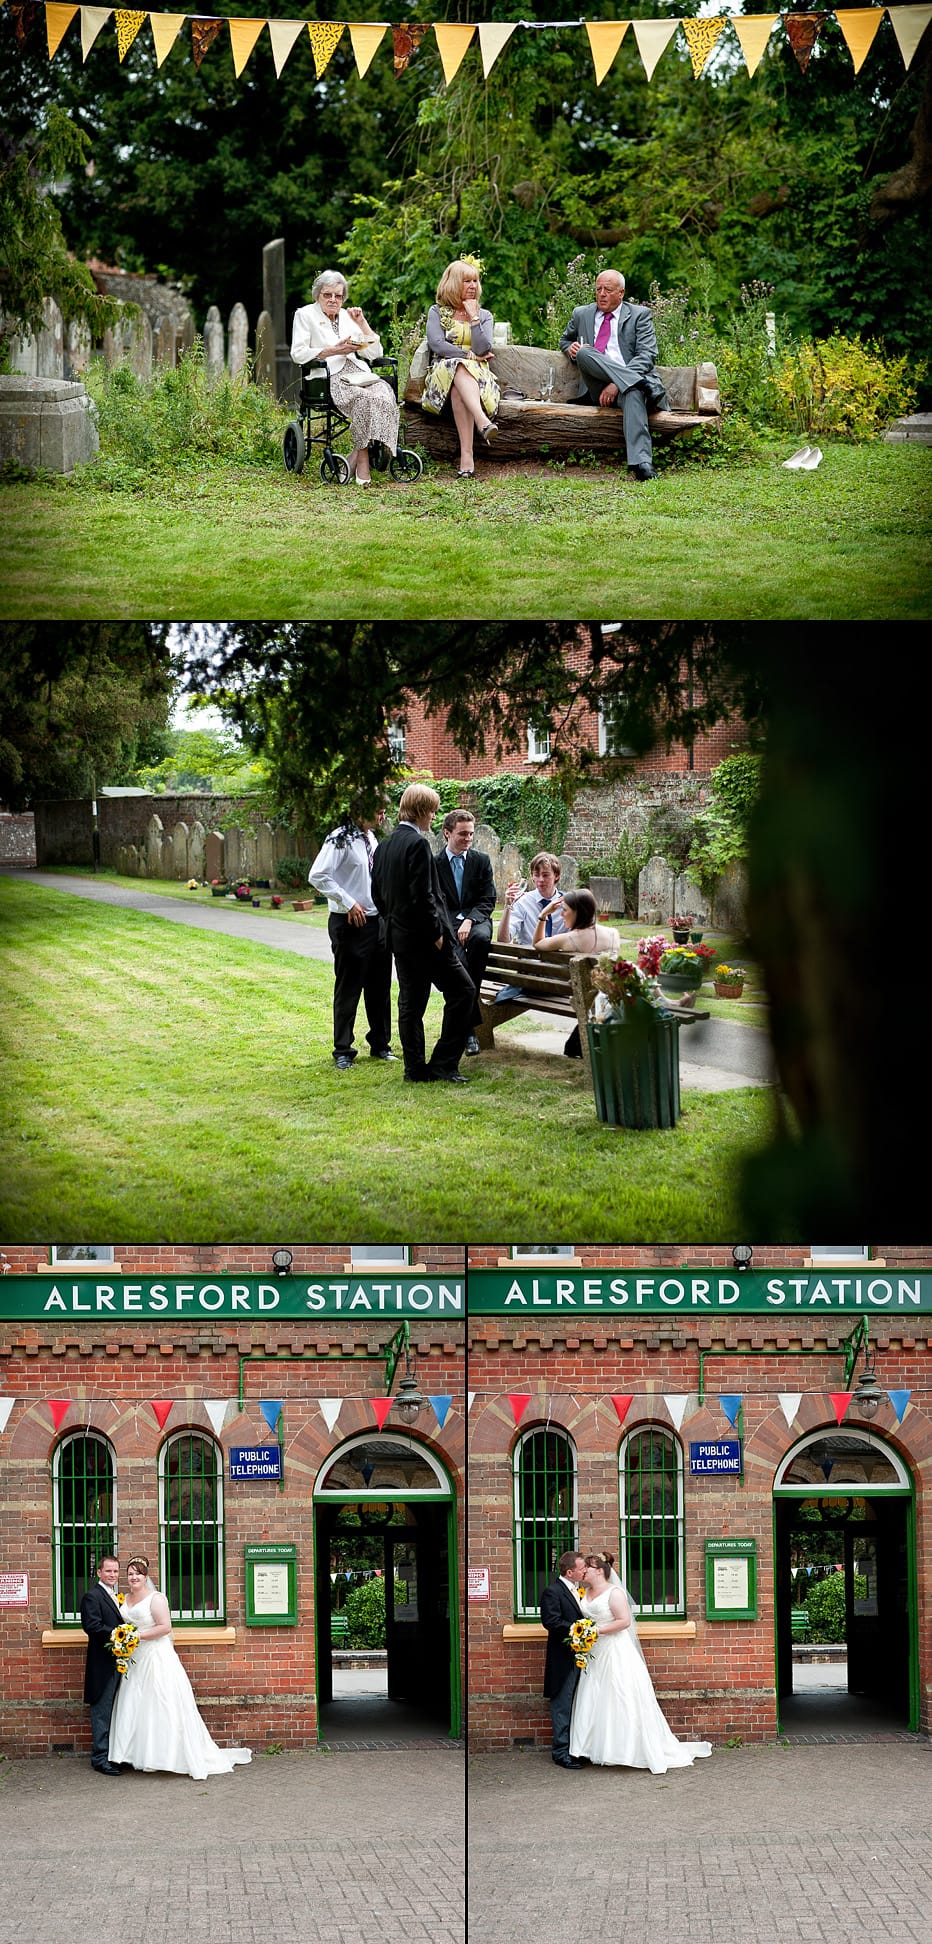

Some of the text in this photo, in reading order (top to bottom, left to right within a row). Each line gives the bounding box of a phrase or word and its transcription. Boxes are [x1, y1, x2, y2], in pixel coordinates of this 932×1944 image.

[44, 1284, 462, 1311] ALRESFORD STATION
[504, 1279, 921, 1305] ALRESFORD STATION
[699, 1445, 730, 1456] PUBLIC
[239, 1451, 270, 1462] PUBLIC
[231, 1464, 279, 1475] TELEPHONE
[691, 1458, 739, 1470] TELEPHONE
